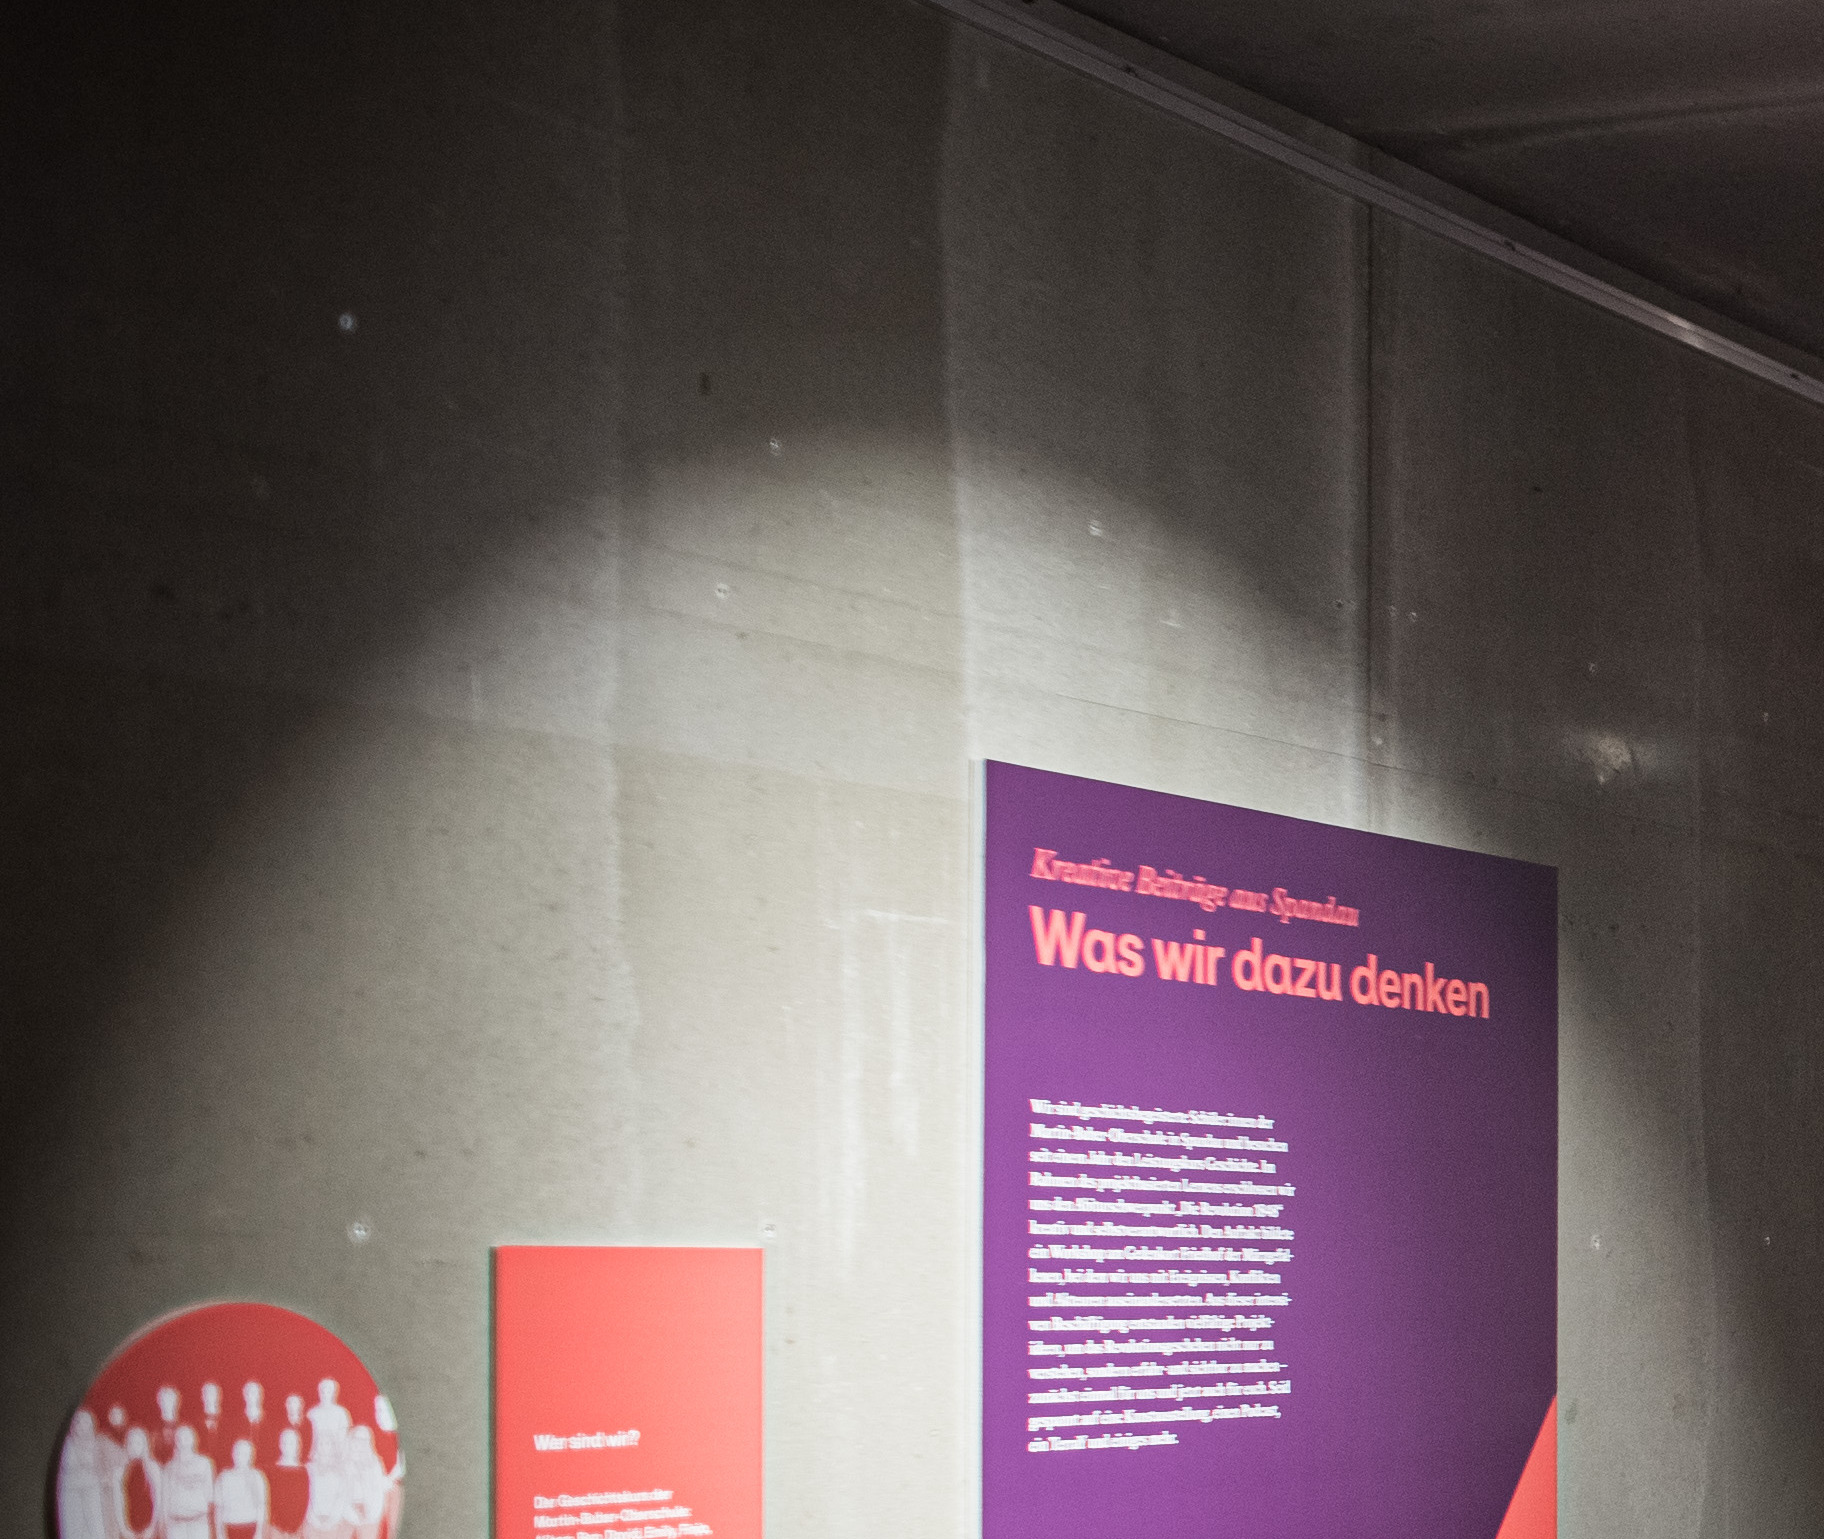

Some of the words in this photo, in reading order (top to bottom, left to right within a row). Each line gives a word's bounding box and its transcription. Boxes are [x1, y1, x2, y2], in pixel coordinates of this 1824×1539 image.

[1030, 847, 1134, 891] Kreative
[1136, 864, 1229, 912] Beiträge
[1229, 886, 1268, 913] aus
[1269, 887, 1360, 927] Spandau
[1029, 905, 1145, 977] Was
[1152, 930, 1225, 986] wir
[1231, 937, 1343, 1001] dazu
[1350, 954, 1489, 1019] denken
[533, 1435, 568, 1451] Wer
[569, 1432, 605, 1449] sind
[605, 1429, 641, 1447] wir?
